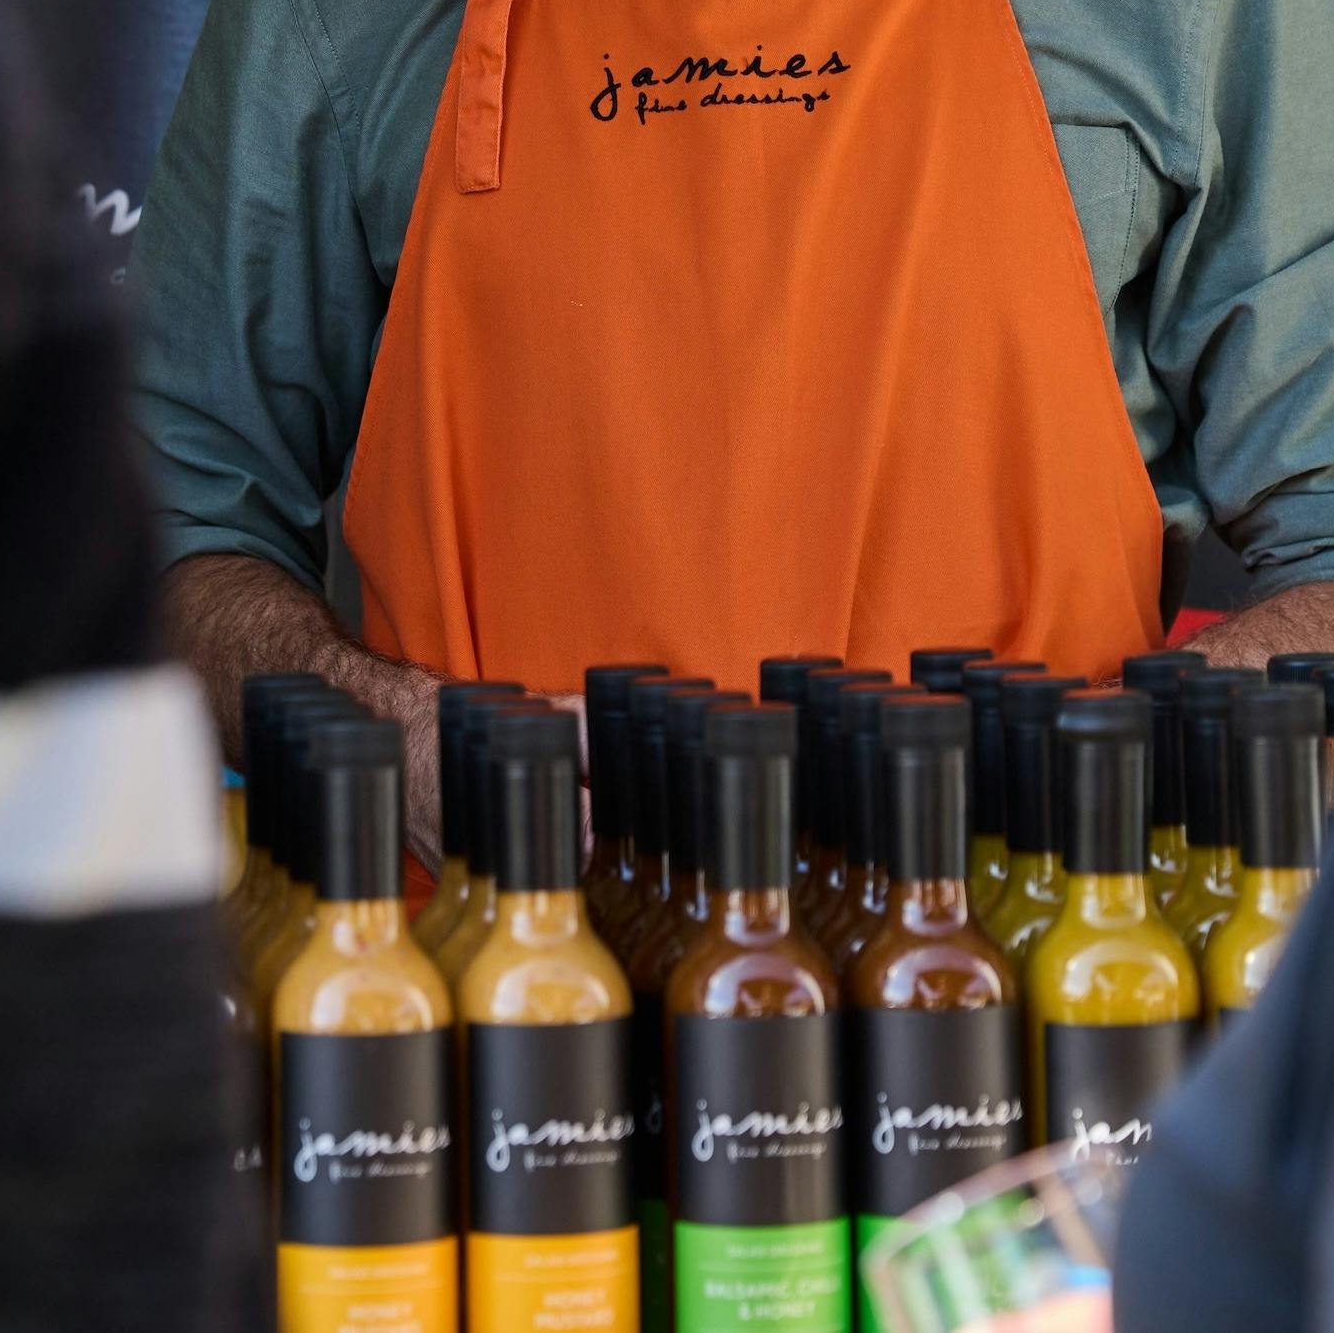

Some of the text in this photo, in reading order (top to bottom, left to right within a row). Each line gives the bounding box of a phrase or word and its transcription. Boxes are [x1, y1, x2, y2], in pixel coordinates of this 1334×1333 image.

[589, 45, 851, 122] jamies
[635, 83, 830, 125] fine dressings
